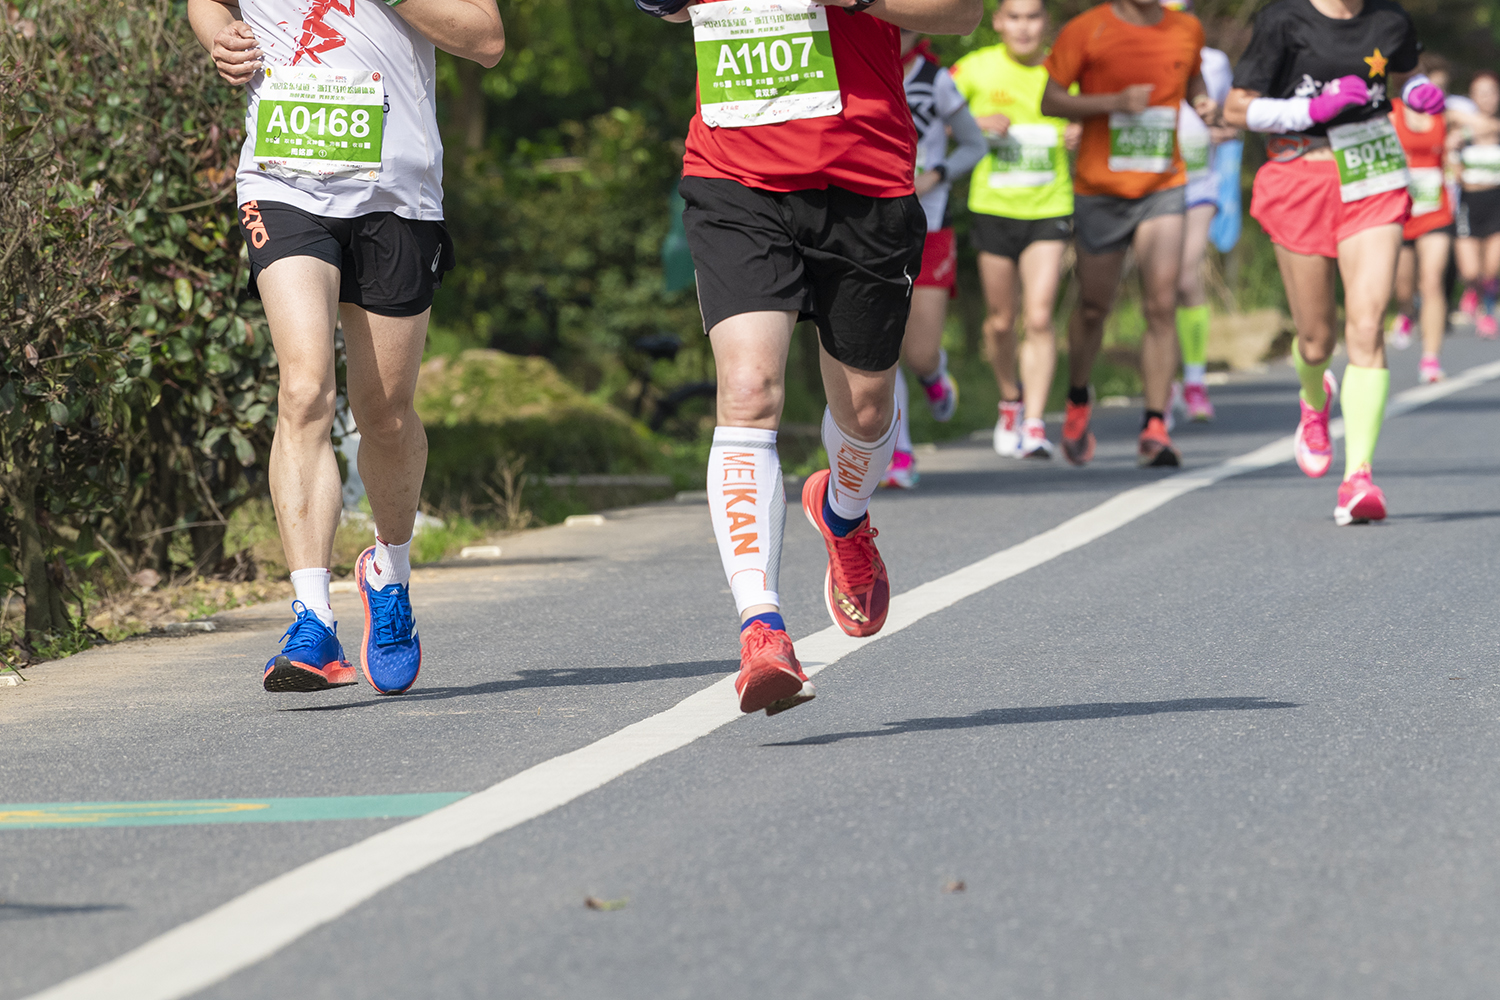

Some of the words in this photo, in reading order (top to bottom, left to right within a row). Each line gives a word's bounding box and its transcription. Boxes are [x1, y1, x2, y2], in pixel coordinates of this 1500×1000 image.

[715, 36, 814, 77] A1107
[266, 105, 370, 138] A0168
[837, 441, 873, 494] MEIKAN
[722, 451, 760, 557] MEIKAN
